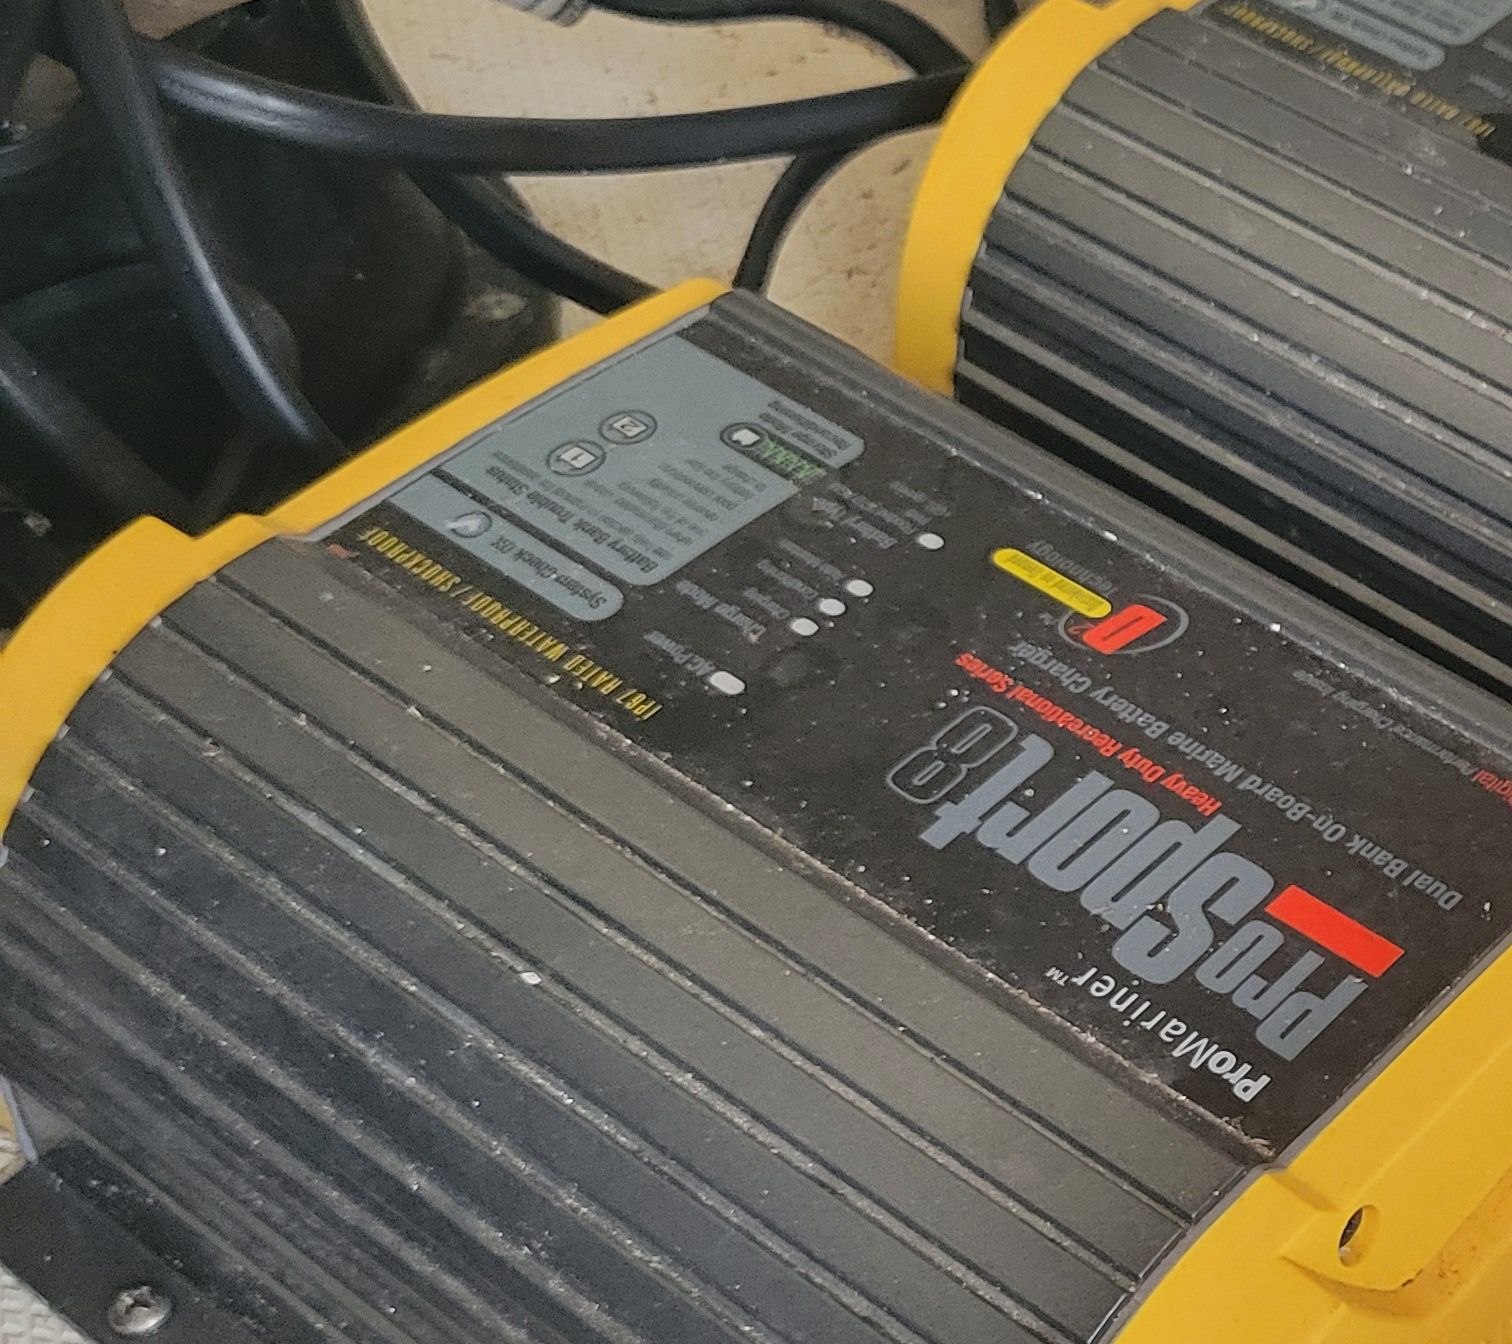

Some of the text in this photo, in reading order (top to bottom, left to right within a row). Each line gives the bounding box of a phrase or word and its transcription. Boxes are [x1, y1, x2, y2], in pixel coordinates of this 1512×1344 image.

[478, 464, 663, 574] Battery Bank Trouble Status
[353, 523, 466, 593] SHOCKPROOF
[507, 546, 561, 579] Check
[547, 569, 612, 609] System
[1020, 536, 1125, 596] Technology
[457, 588, 575, 662] WATERPROOF
[559, 652, 626, 695] RATED
[612, 686, 666, 721] IP67
[948, 650, 1229, 817] Heavy Duty Recreational Series
[1002, 636, 1466, 911] Dual Bank On-Board Marine Battery Charger
[878, 702, 1372, 1061] ProSport 8
